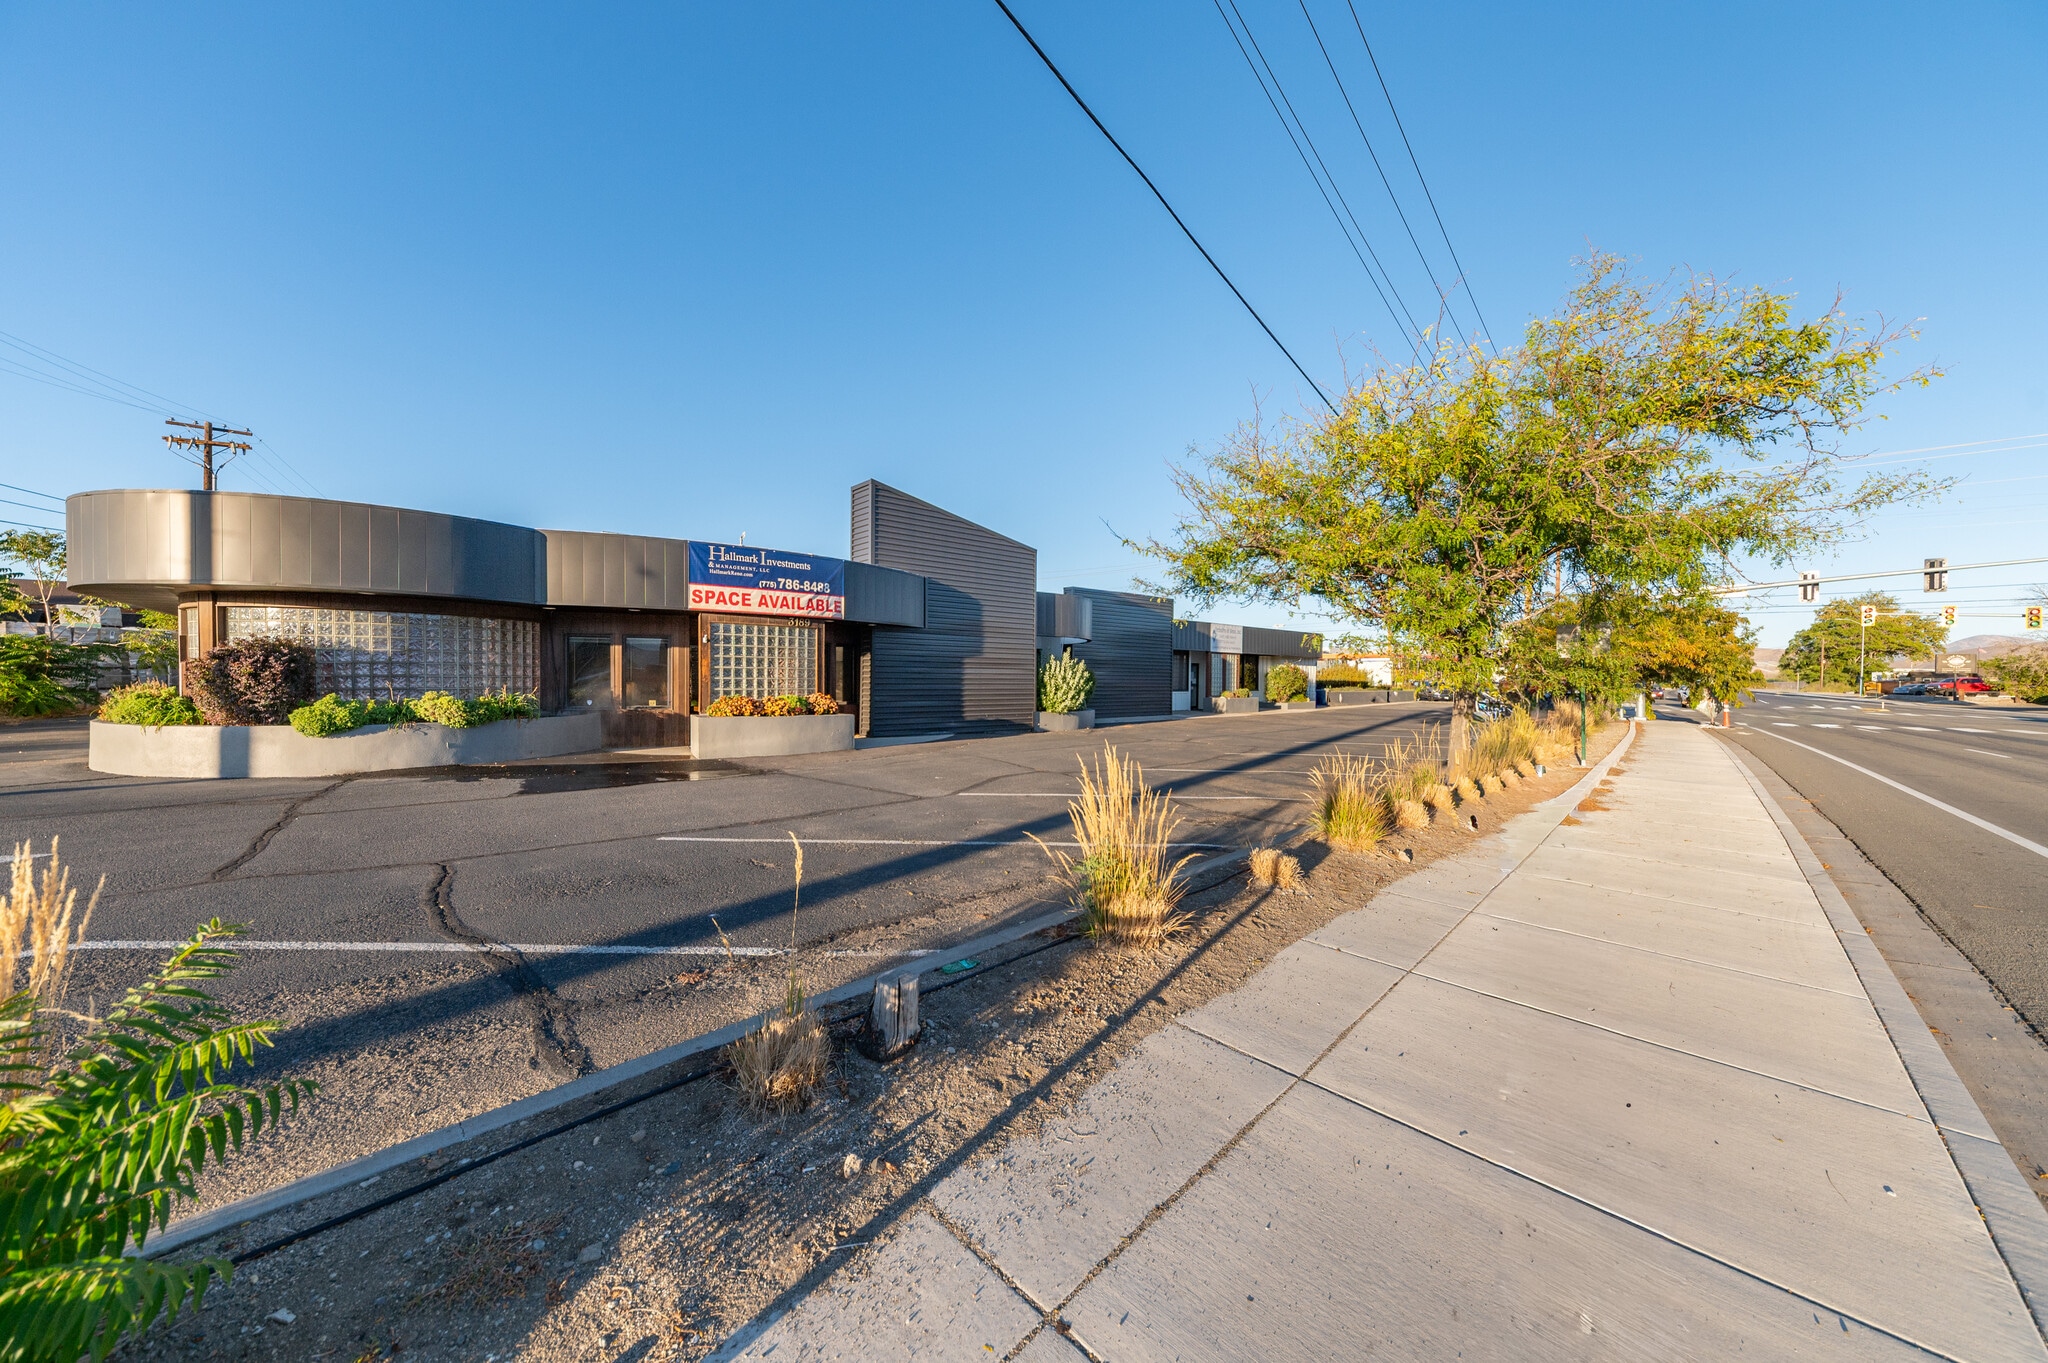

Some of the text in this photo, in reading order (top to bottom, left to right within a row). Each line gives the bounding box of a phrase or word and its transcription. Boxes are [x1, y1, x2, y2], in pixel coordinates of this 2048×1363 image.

[708, 545, 811, 571] Hallmark Investments
[759, 578, 830, 594] (775) 786-8488
[692, 589, 842, 613] SPACE AVAILABLE
[787, 617, 811, 627] 3189
